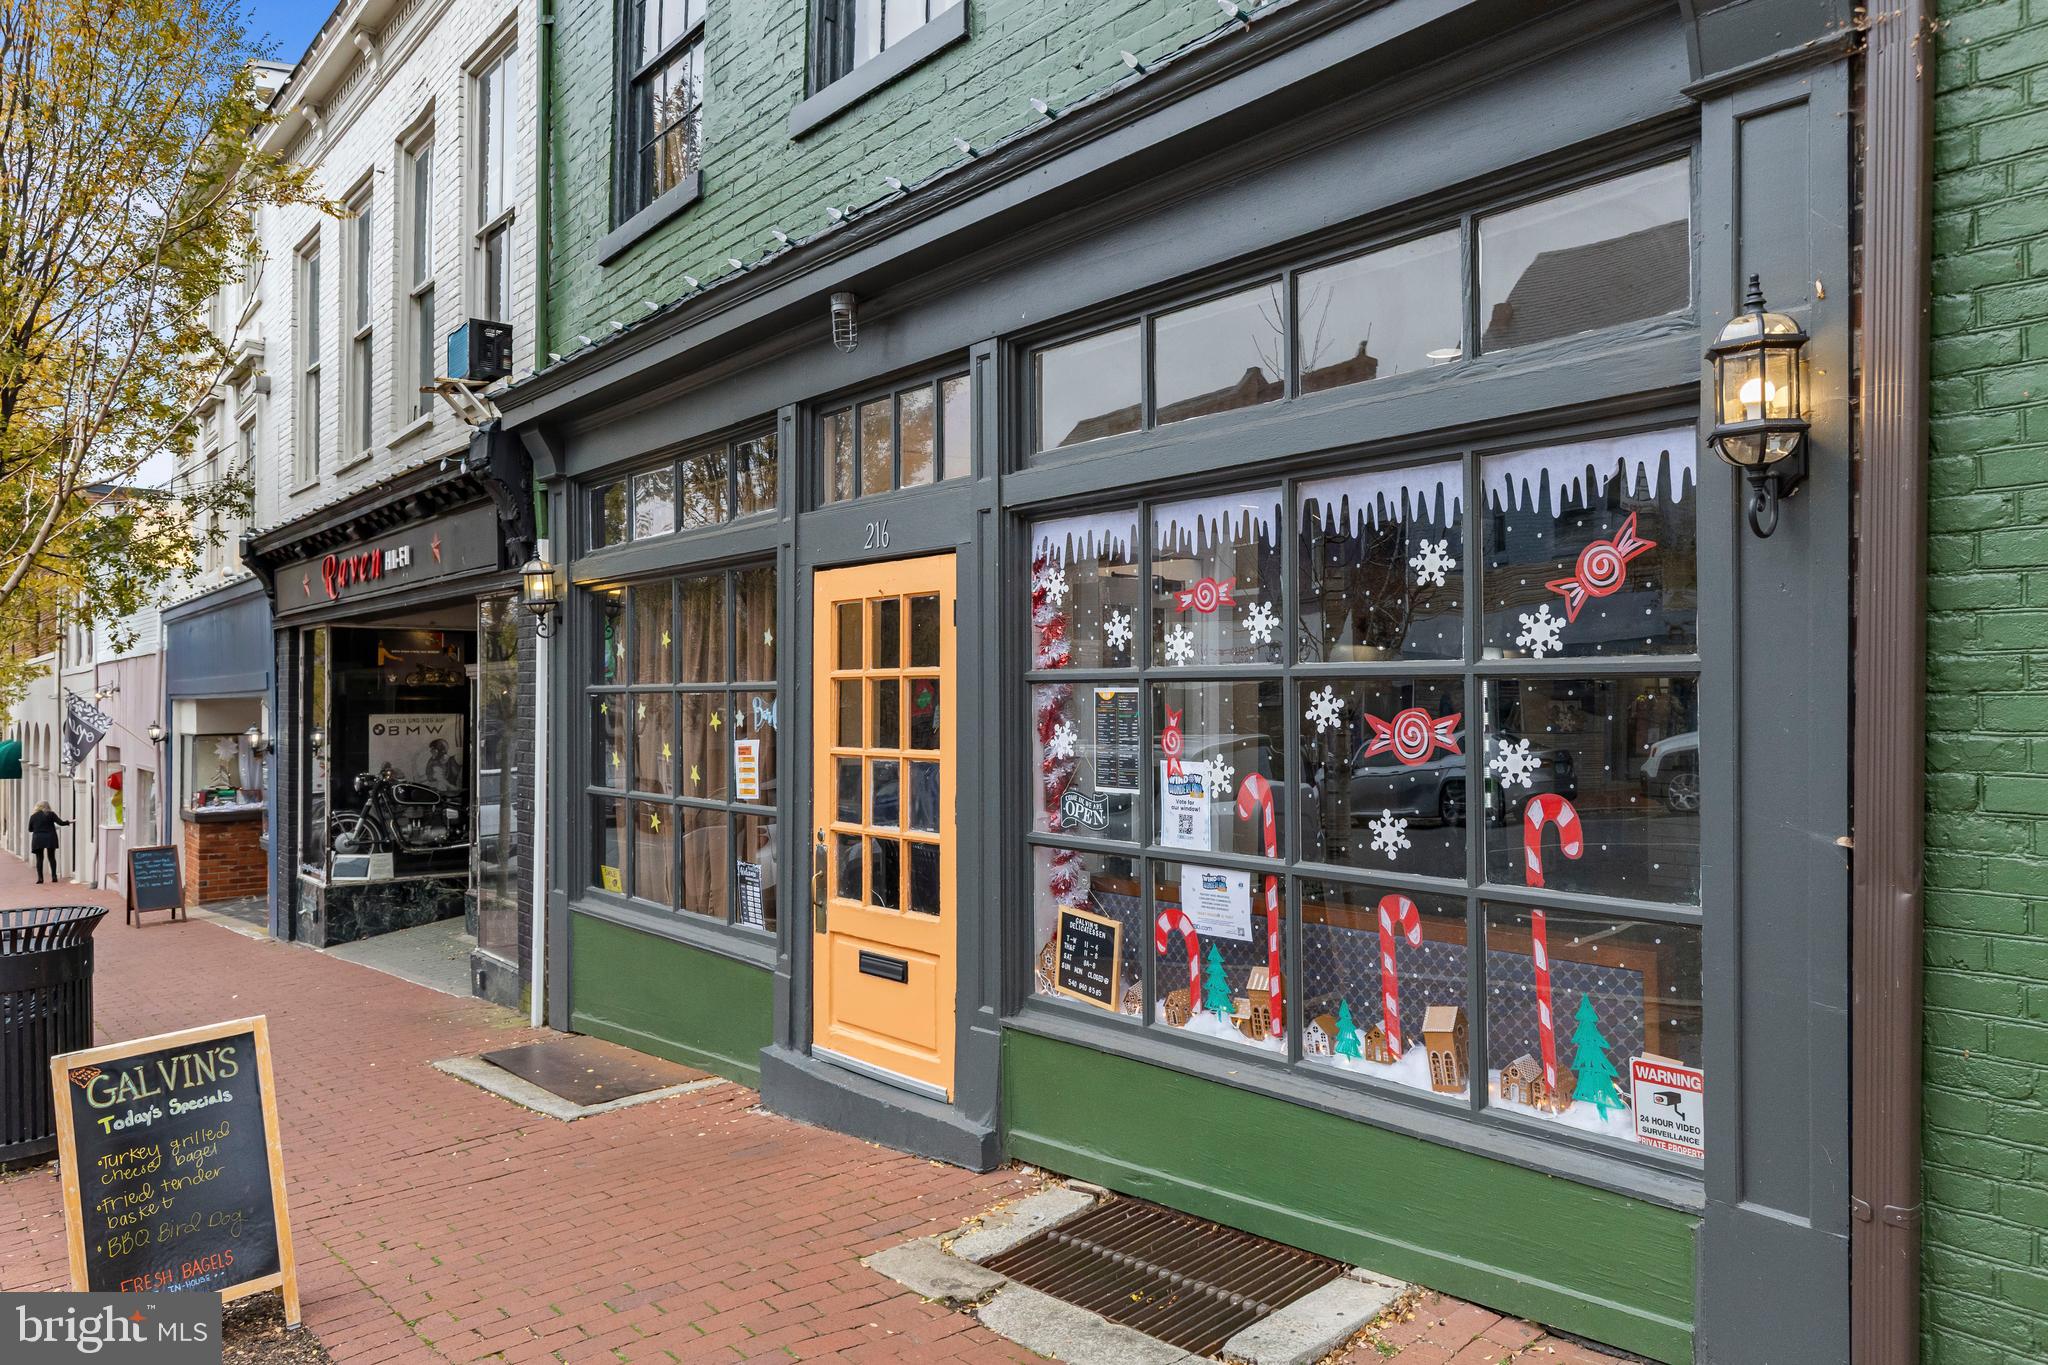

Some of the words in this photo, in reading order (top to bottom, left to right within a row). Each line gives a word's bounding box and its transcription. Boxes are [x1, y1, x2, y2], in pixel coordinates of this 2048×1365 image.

[864, 519, 889, 549] 216
[321, 548, 381, 600] Raven
[388, 724, 444, 736] BMW
[1065, 800, 1104, 825] OPEN
[1069, 921, 1106, 939] DELICATESSEN
[1061, 962, 1071, 970] SUN
[86, 1046, 239, 1109] GALVIN'S
[1635, 1065, 1702, 1090] WARNING
[97, 1104, 163, 1135] Today's
[168, 1089, 234, 1115] Specials
[1640, 1114, 1649, 1123] 24
[1651, 1117, 1674, 1129] HOUR
[1675, 1122, 1701, 1135] VIDEO
[101, 1145, 162, 1169] Turkey
[170, 1120, 231, 1156] grilled
[1638, 1136, 1666, 1151] PRIVATE
[1641, 1125, 1700, 1145] SURVEILLANCE
[101, 1161, 159, 1185] cheese
[175, 1143, 218, 1168] bagel
[160, 1166, 225, 1192] tender
[107, 1197, 175, 1229] basket
[108, 1229, 150, 1258] BBQ
[157, 1211, 202, 1243] Bird
[207, 1209, 248, 1238] Dog
[120, 1268, 173, 1293] FRESH
[181, 1249, 235, 1280] BAGELS
